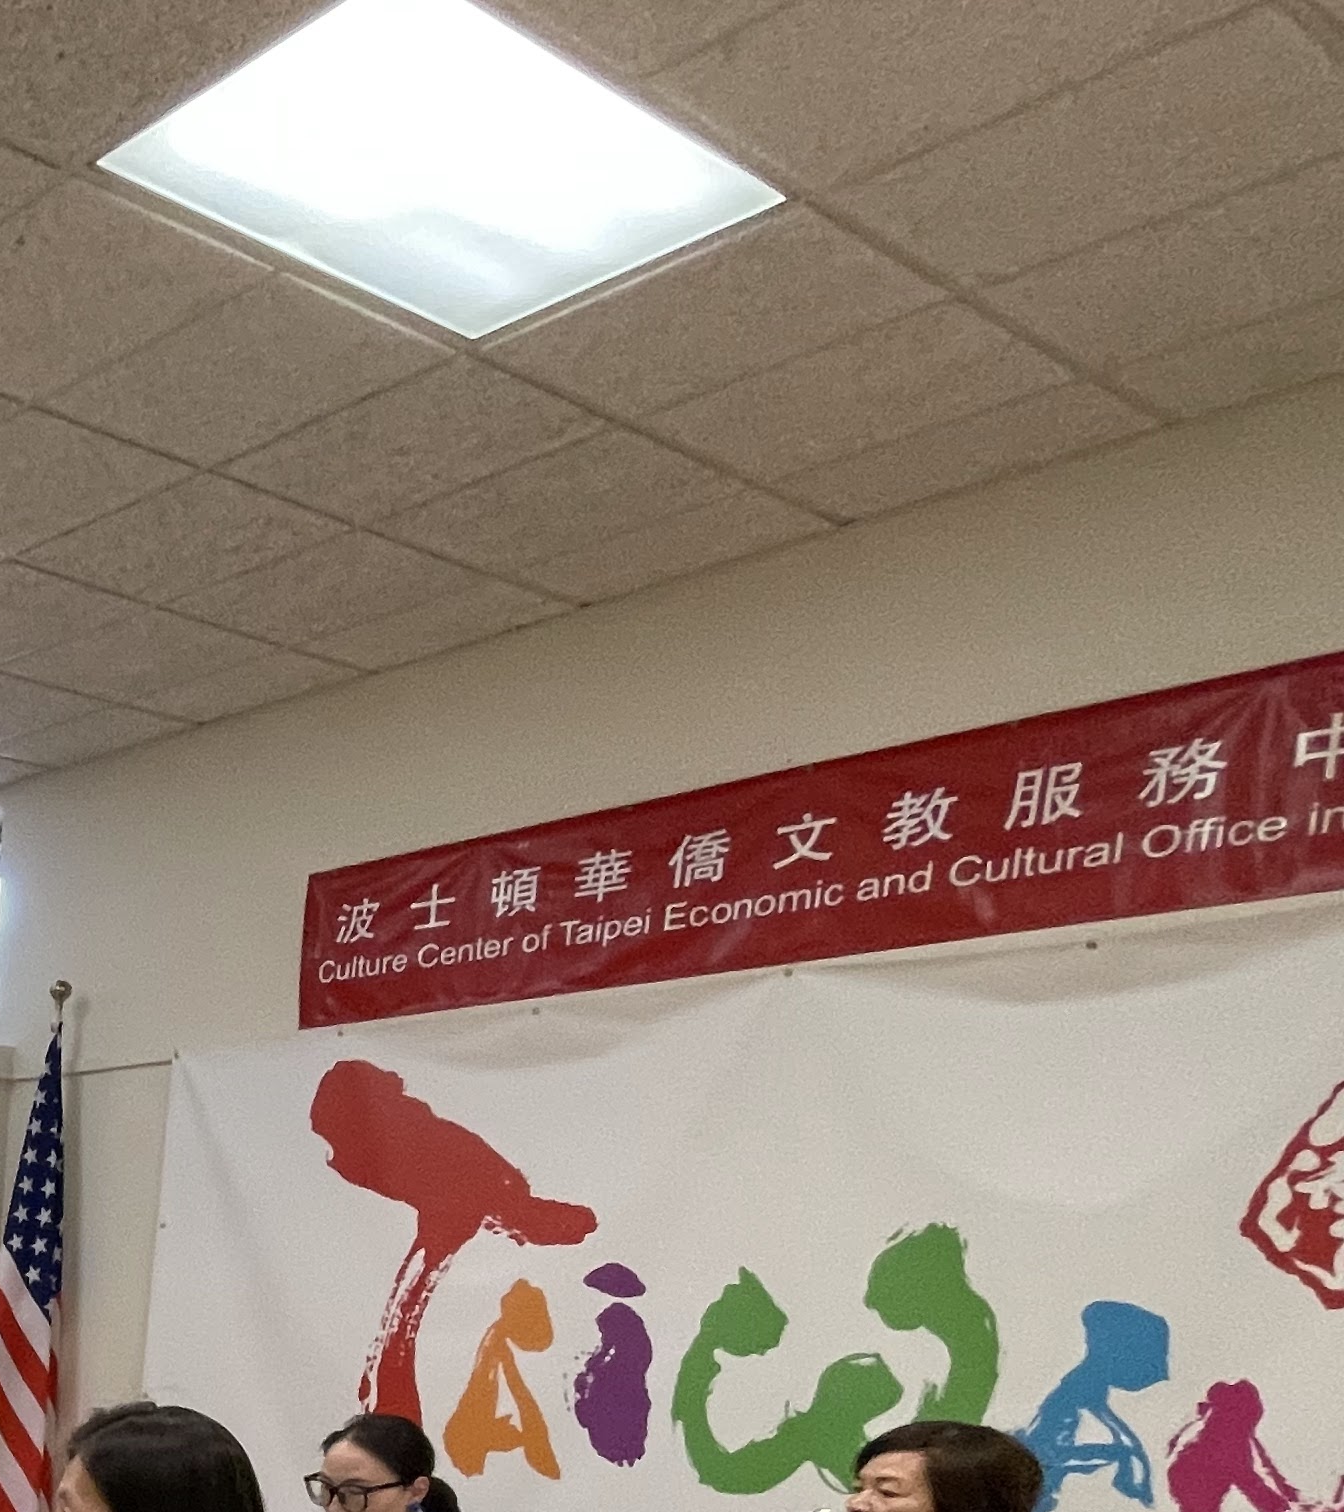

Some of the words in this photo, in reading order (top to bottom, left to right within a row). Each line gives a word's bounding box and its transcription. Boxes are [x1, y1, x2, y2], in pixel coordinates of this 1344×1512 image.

[318, 950, 408, 984] Culture
[417, 935, 514, 969] Center
[521, 925, 553, 953] of
[559, 907, 652, 948] Taipei
[663, 880, 845, 933] Economic
[856, 861, 934, 902] and
[948, 832, 1124, 888] Cultural
[1141, 815, 1288, 859] Office
[1308, 801, 1344, 837] in
